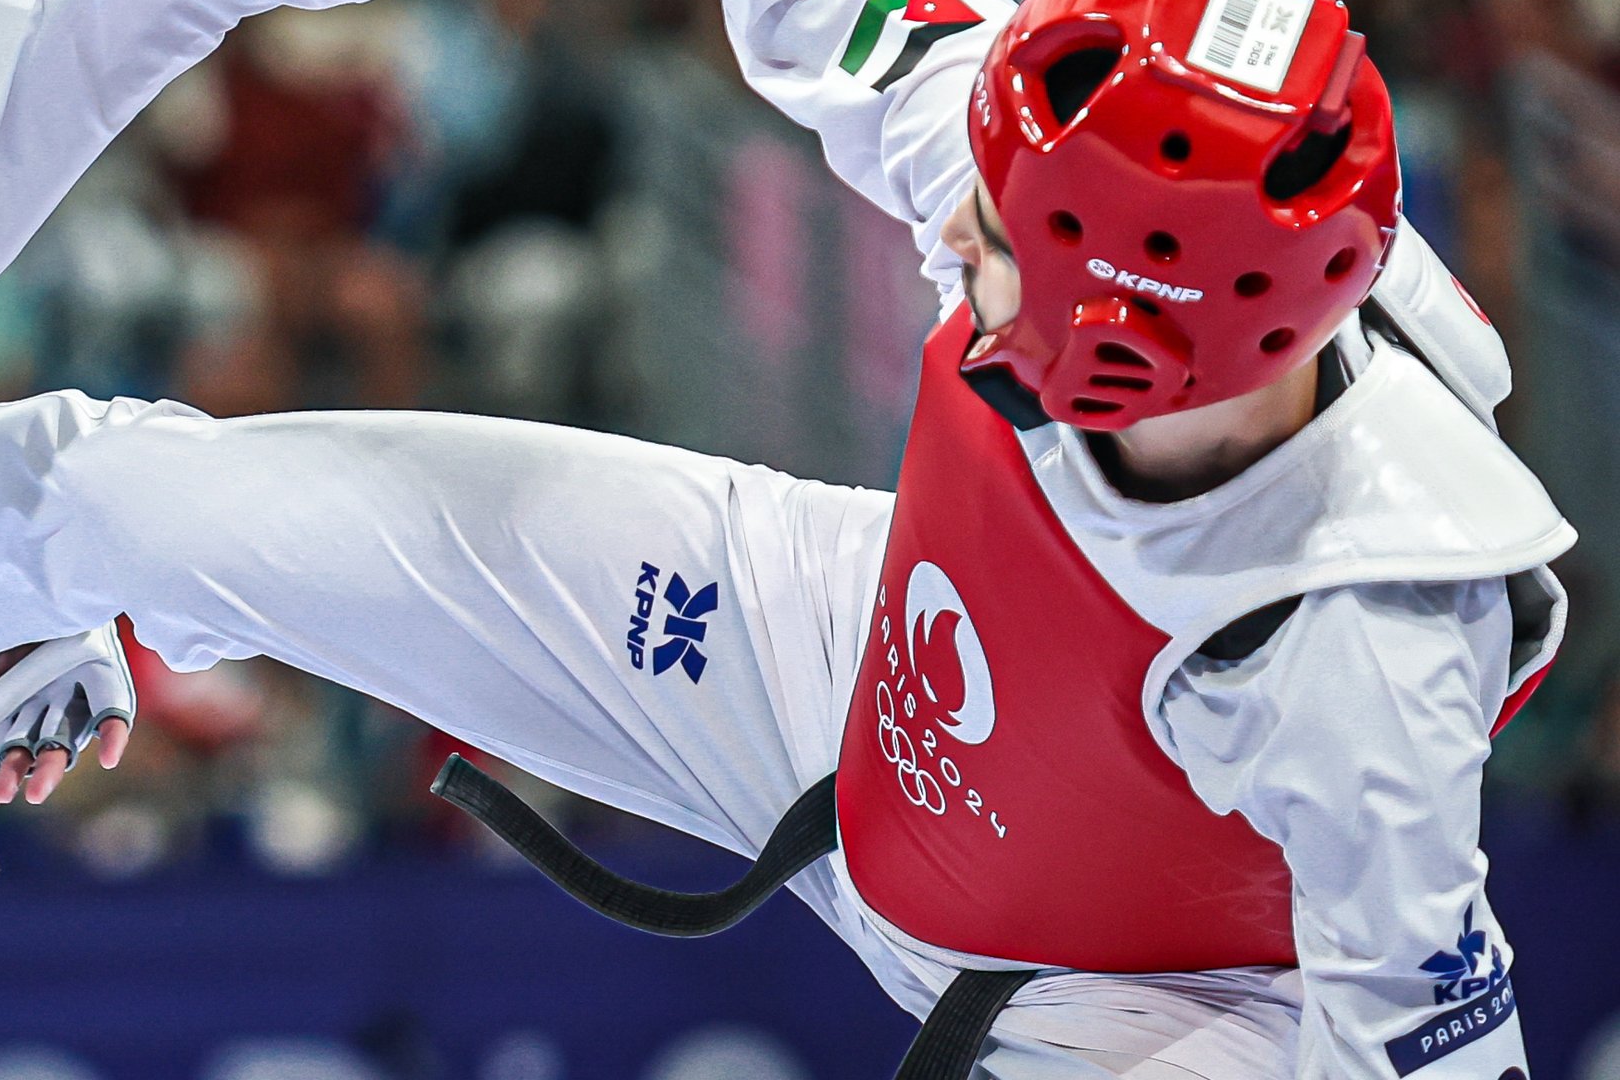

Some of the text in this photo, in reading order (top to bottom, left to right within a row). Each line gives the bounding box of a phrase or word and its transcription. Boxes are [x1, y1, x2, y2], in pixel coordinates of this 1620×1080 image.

[1115, 269, 1205, 303] KPNP
[626, 560, 661, 670] KPNP
[921, 727, 1007, 840] 2024
